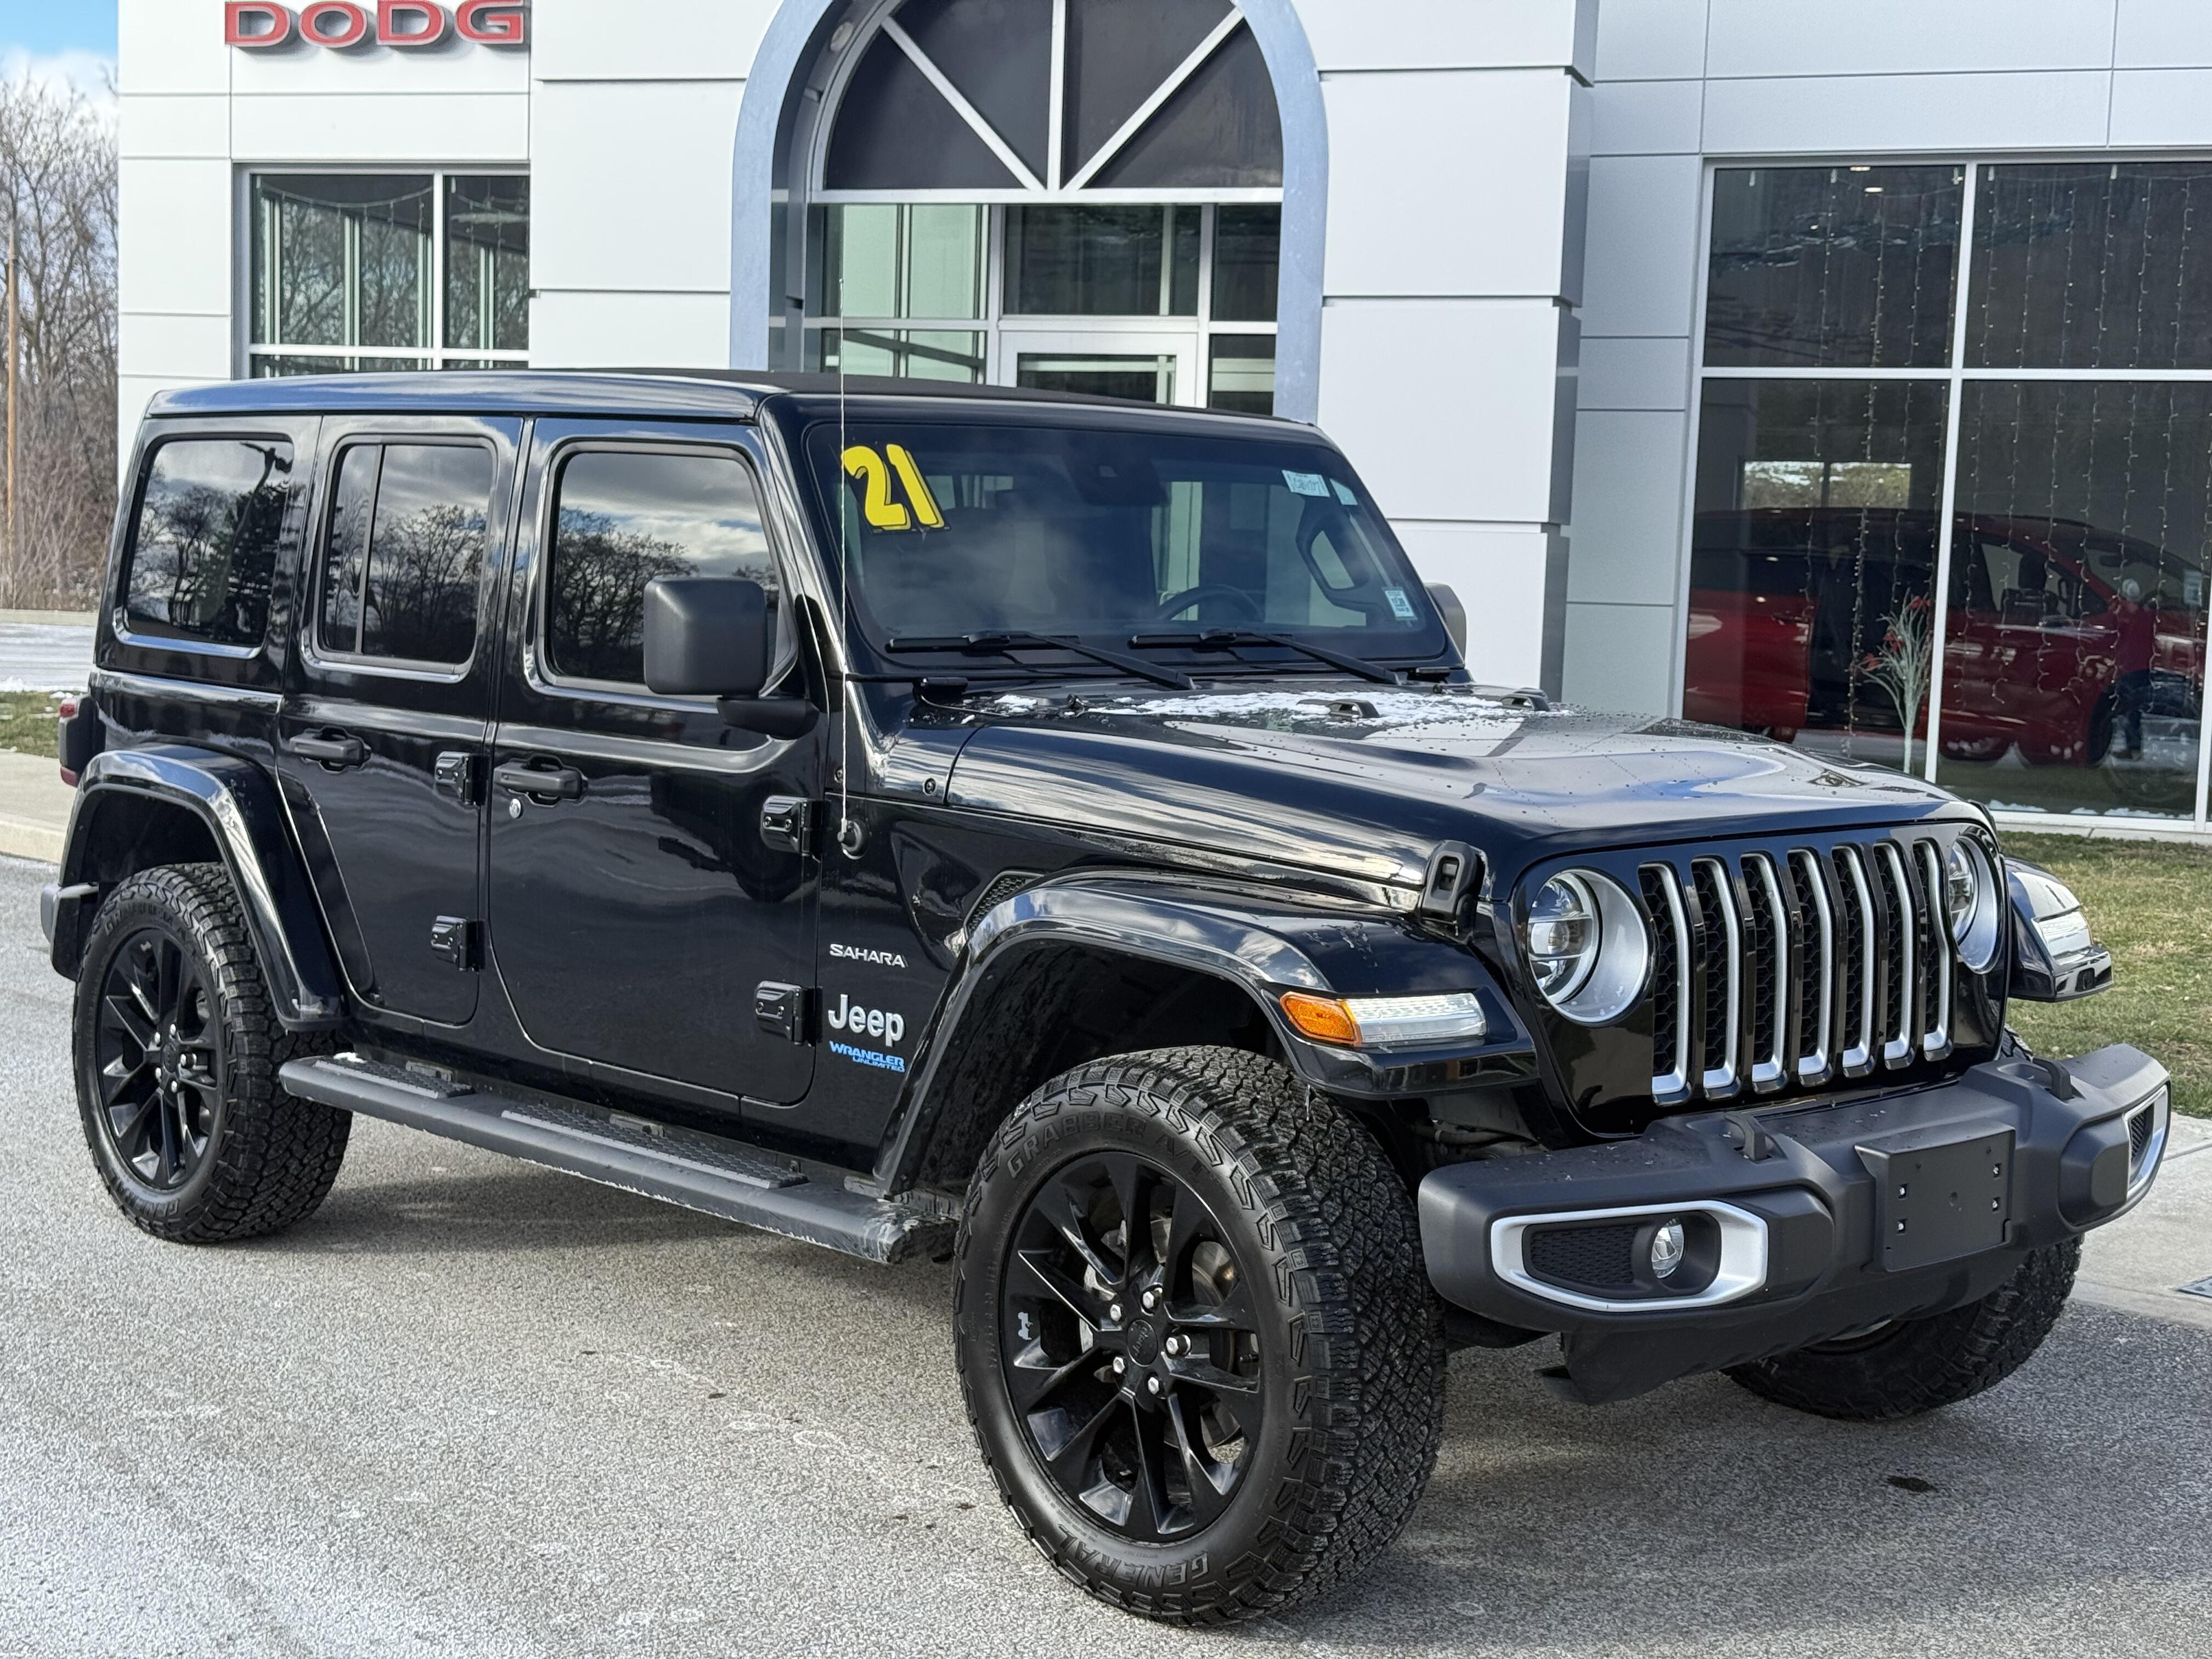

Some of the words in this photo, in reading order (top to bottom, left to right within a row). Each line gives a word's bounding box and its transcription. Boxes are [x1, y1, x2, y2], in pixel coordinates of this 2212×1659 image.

[841, 444, 945, 531] 21
[830, 943, 907, 968] SAHARA
[828, 994, 905, 1047] Jeep
[829, 1040, 905, 1066] WRANGLER
[853, 1056, 905, 1073] UNLIMITED
[1006, 1111, 1147, 1178] GRABBER
[1058, 1524, 1209, 1587] GENERAL
